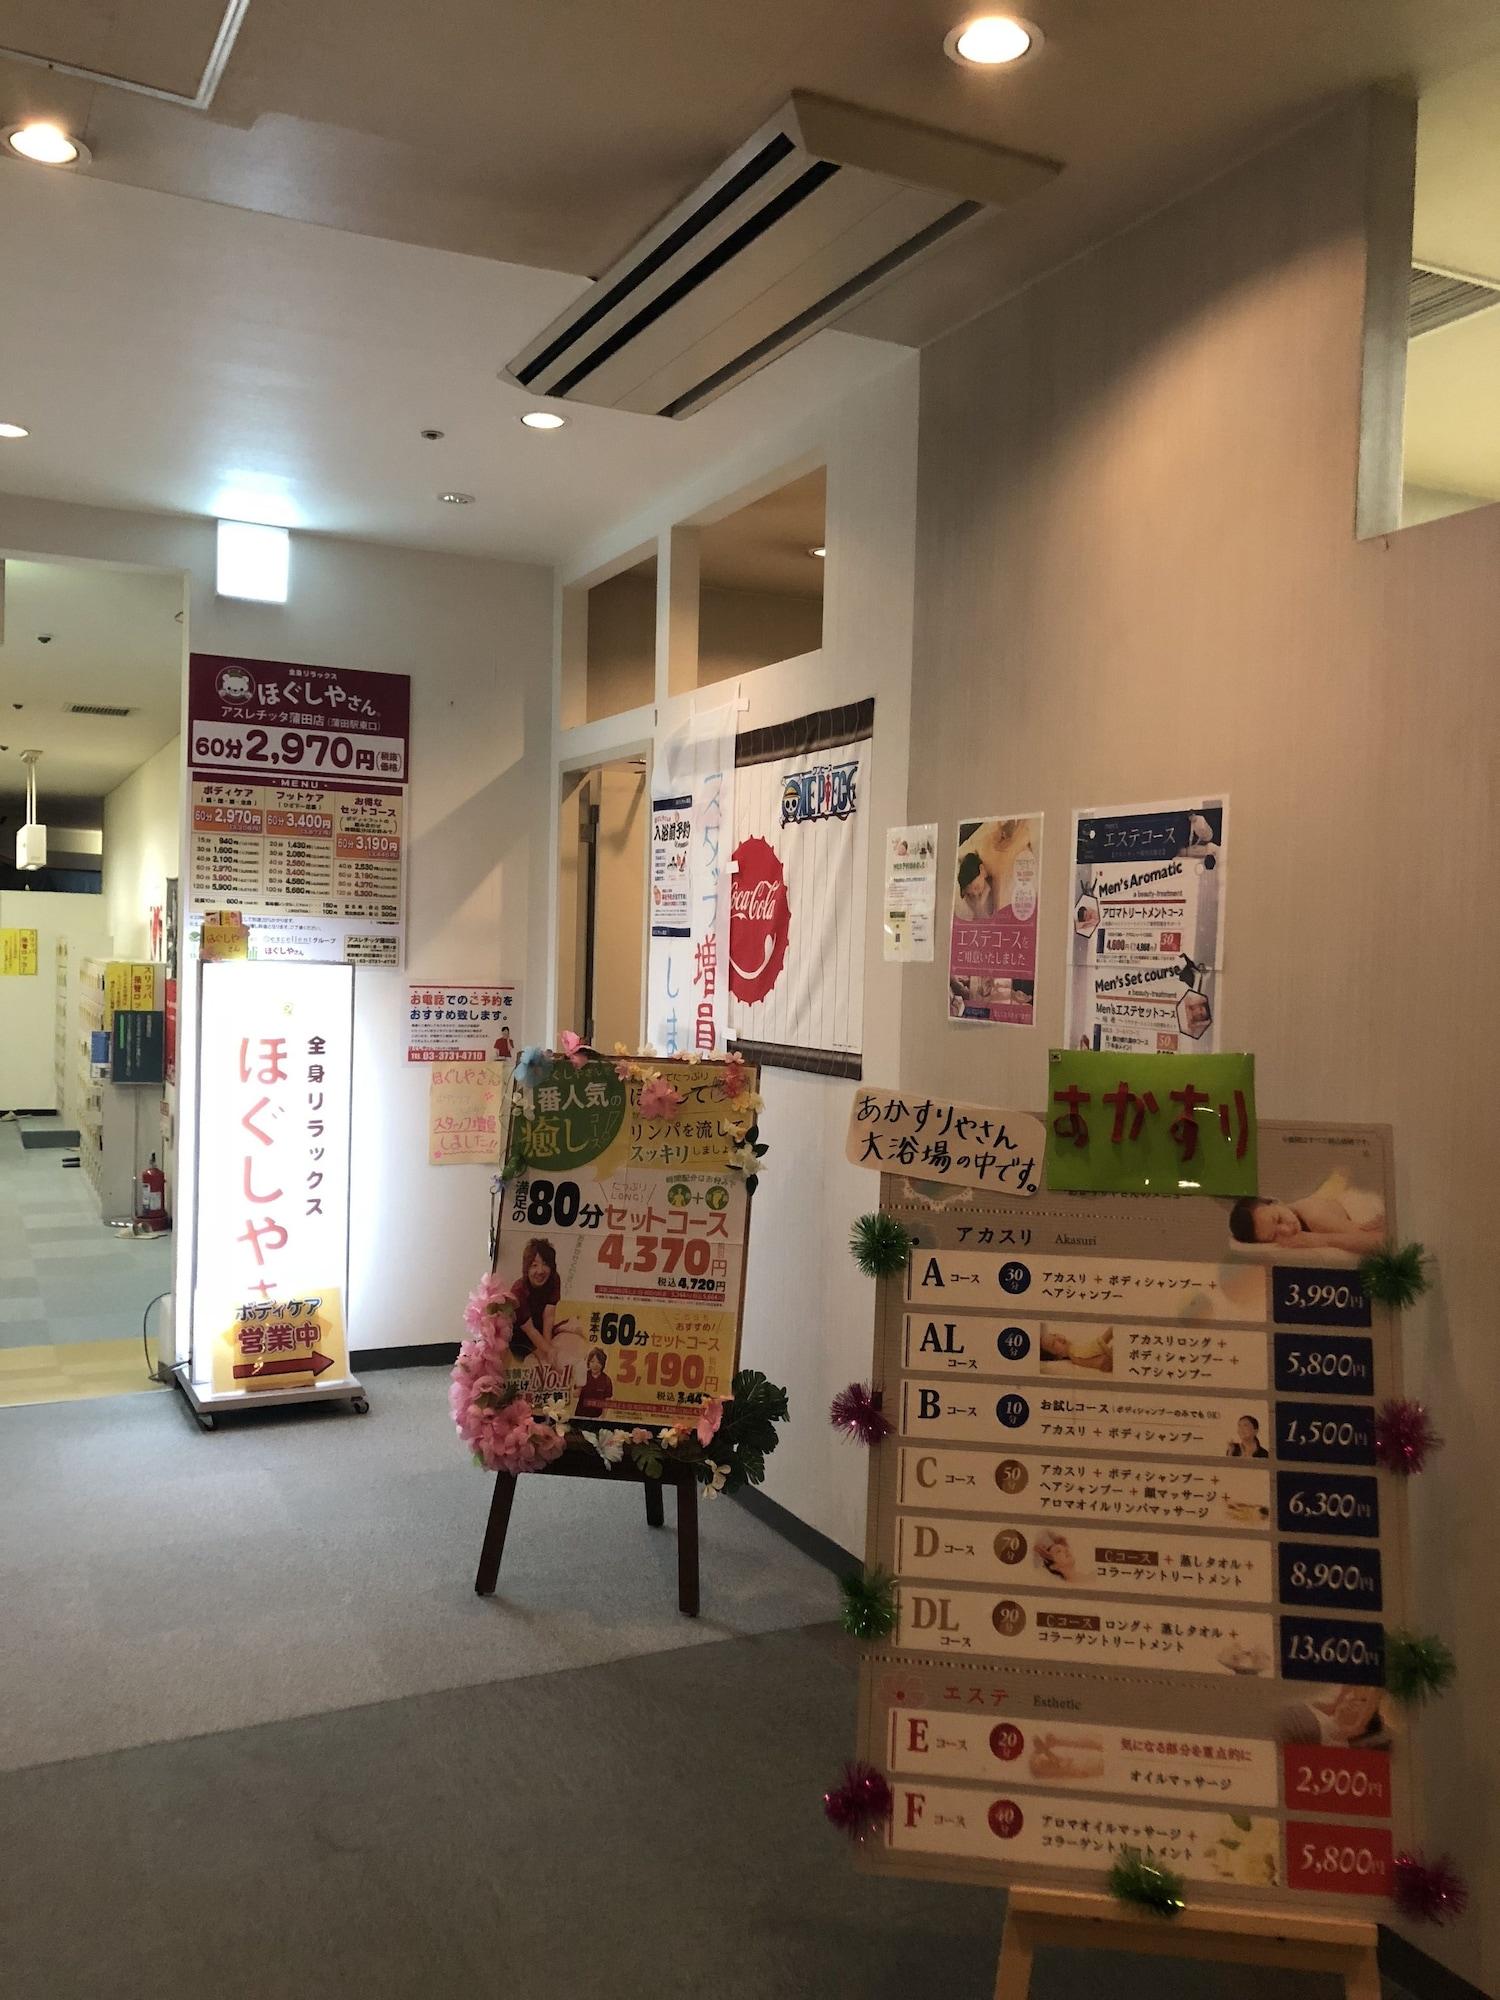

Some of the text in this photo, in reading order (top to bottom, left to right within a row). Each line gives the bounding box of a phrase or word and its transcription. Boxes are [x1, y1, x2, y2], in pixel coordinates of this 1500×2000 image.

[257, 681, 377, 717] ほぐしやさん
[221, 706, 325, 727] アスレチッタ蒲田店
[195, 729, 375, 772] 60分 2,970円
[203, 786, 254, 797] ボディケア
[281, 779, 319, 789] MENU
[276, 791, 325, 803] フットケア
[215, 808, 261, 825] 2,970円
[286, 812, 332, 829] 3,400円
[341, 805, 397, 817] セットコース
[355, 835, 398, 852] 3,190円
[1103, 826, 1177, 848] エステコース
[1099, 861, 1183, 898] Men's Aromatic
[1102, 907, 1184, 919] アロマトリートメントコース
[957, 928, 1030, 949] エステコースを
[957, 950, 1026, 966] ご用意いたしました
[1095, 965, 1180, 993] Men's Set course
[410, 994, 513, 1007] お電話でのご予約を
[410, 1009, 508, 1021] おすすめ致します。
[305, 1034, 327, 1218] 全身リラックス
[856, 1094, 1019, 1151] あかすりやさん
[1053, 1080, 1250, 1162] あかすり
[521, 1116, 589, 1158] 癒し
[861, 1131, 1038, 1194] 大浴場の中です。
[511, 1180, 529, 1223] 満足の
[526, 1179, 604, 1229] 80分
[605, 1204, 729, 1239] セットコース
[956, 1226, 1033, 1246] アカスリ
[1055, 1232, 1098, 1246] Akasuri
[597, 1233, 728, 1278] 4,370円
[921, 1257, 946, 1288] A
[950, 1273, 981, 1284] コース
[1005, 1267, 1024, 1281] 30
[1042, 1272, 1203, 1288] アカスリ ボディシャンプー
[1042, 1289, 1123, 1300] ヘアシャンプー
[1284, 1283, 1364, 1309] 3,990円
[236, 1298, 322, 1322] ボディケア
[238, 1322, 321, 1355] 営業中
[589, 1312, 601, 1345] 基本の
[600, 1312, 650, 1347] 60分
[919, 1321, 965, 1354] AL
[651, 1332, 720, 1351] セットコース
[1004, 1334, 1023, 1348] 40
[1128, 1334, 1213, 1347] アカスリロング
[948, 1359, 979, 1369] コース
[1128, 1350, 1224, 1364] ボディシャンプー
[1286, 1351, 1366, 1377] 5,800円
[529, 1364, 573, 1391] No.1
[616, 1349, 719, 1392] 3,190円
[1128, 1366, 1213, 1379] ヘアシャンプー
[917, 1389, 941, 1419] B
[947, 1406, 978, 1417] コース
[1005, 1401, 1023, 1415] 10
[1040, 1400, 1110, 1414] お試しコース
[1040, 1424, 1205, 1443] アカスリ ボディシャンプー
[1285, 1420, 1368, 1447] 1,500円
[916, 1456, 938, 1489] C
[944, 1475, 976, 1486] コース
[1003, 1467, 1021, 1481] 50
[1040, 1464, 1205, 1483] アカスリ ボディシャンプー
[1040, 1481, 1124, 1495] ヘアシャンプー
[1040, 1497, 1210, 1518] アロマオイルリンパマッサージ
[1288, 1492, 1372, 1519] 6,300円
[913, 1525, 940, 1558] D
[944, 1543, 975, 1555] コース
[1104, 1549, 1152, 1565] Cコース
[1096, 1566, 1242, 1587] コラーゲントリートメント
[1289, 1562, 1375, 1593] 8,900円
[911, 1596, 960, 1632] DL
[1000, 1609, 1019, 1623] 90
[1046, 1614, 1094, 1630] Cコース
[940, 1636, 971, 1648] コース
[1038, 1631, 1185, 1653] コラーゲントリートメント
[1287, 1634, 1380, 1667] 13,600円
[943, 1687, 1009, 1707] エステ
[1033, 1694, 1082, 1711] Esthetic
[907, 1718, 929, 1753] E
[936, 1739, 968, 1751] コース
[1130, 1770, 1232, 1790] オイルマッサージ
[1296, 1765, 1384, 1801] 2,900円
[904, 1791, 926, 1829] F
[934, 1814, 967, 1829] コース
[1042, 1816, 1182, 1841] アロマオイルマッサージ
[1300, 1841, 1385, 1877] 5,800円
